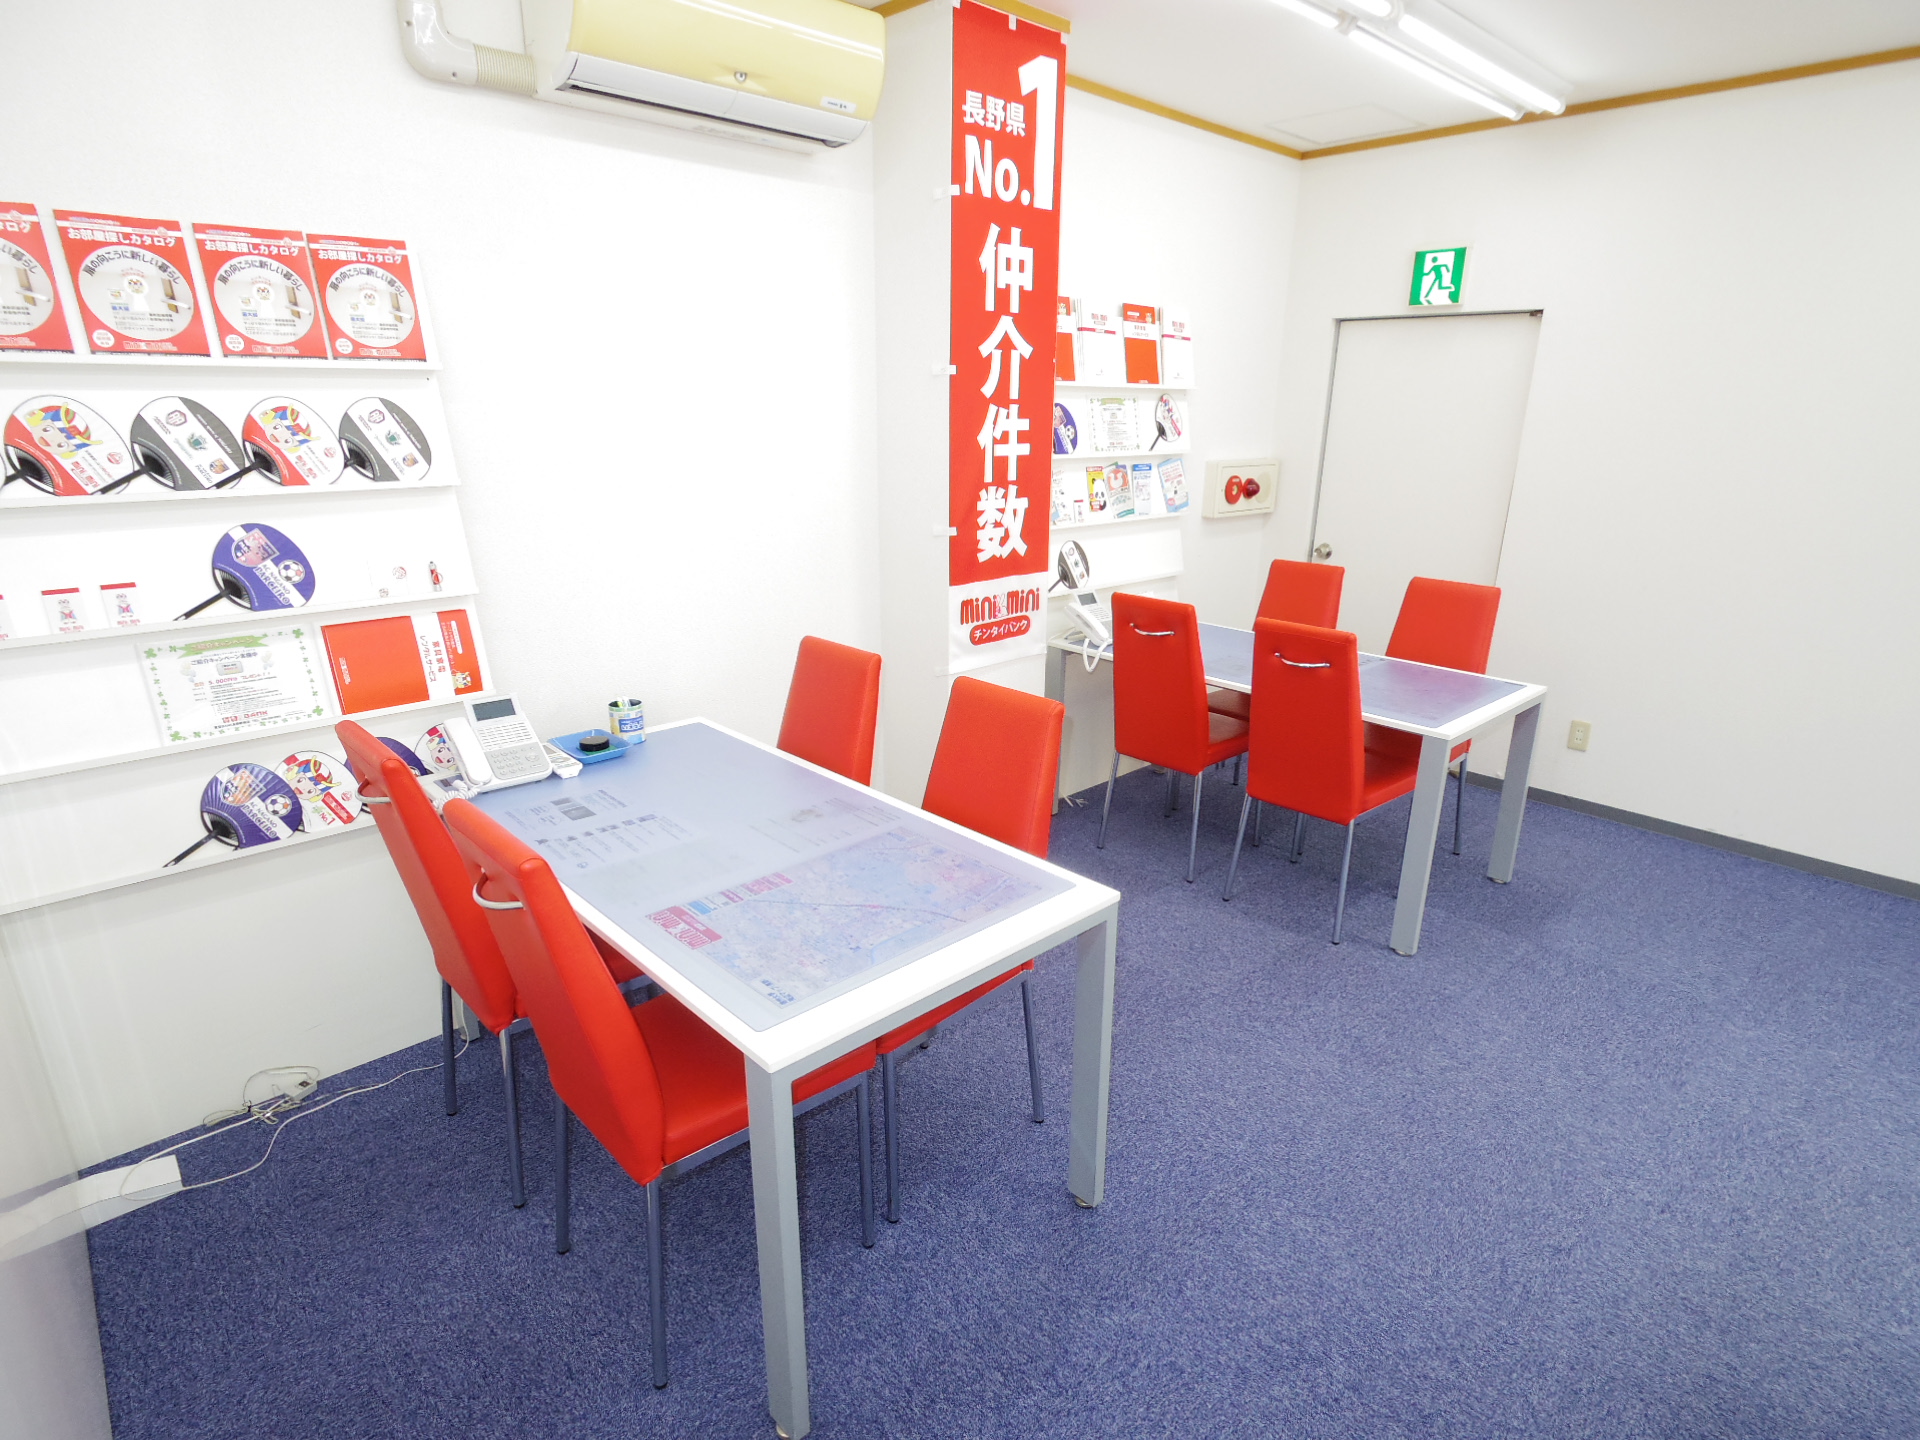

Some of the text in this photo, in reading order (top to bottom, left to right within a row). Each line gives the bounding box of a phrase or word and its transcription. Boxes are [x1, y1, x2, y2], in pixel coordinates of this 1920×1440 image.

[962, 89, 1026, 137] 長野県
[67, 227, 177, 248] お部屋探しカタログ
[204, 240, 300, 257] お部屋探しカタログ
[82, 249, 181, 285] 扉の向こうに新しい暮らし
[976, 222, 1035, 564] 仲介件数
[973, 619, 1029, 642] チンタイバンク
[420, 635, 437, 683] レンタルサービス
